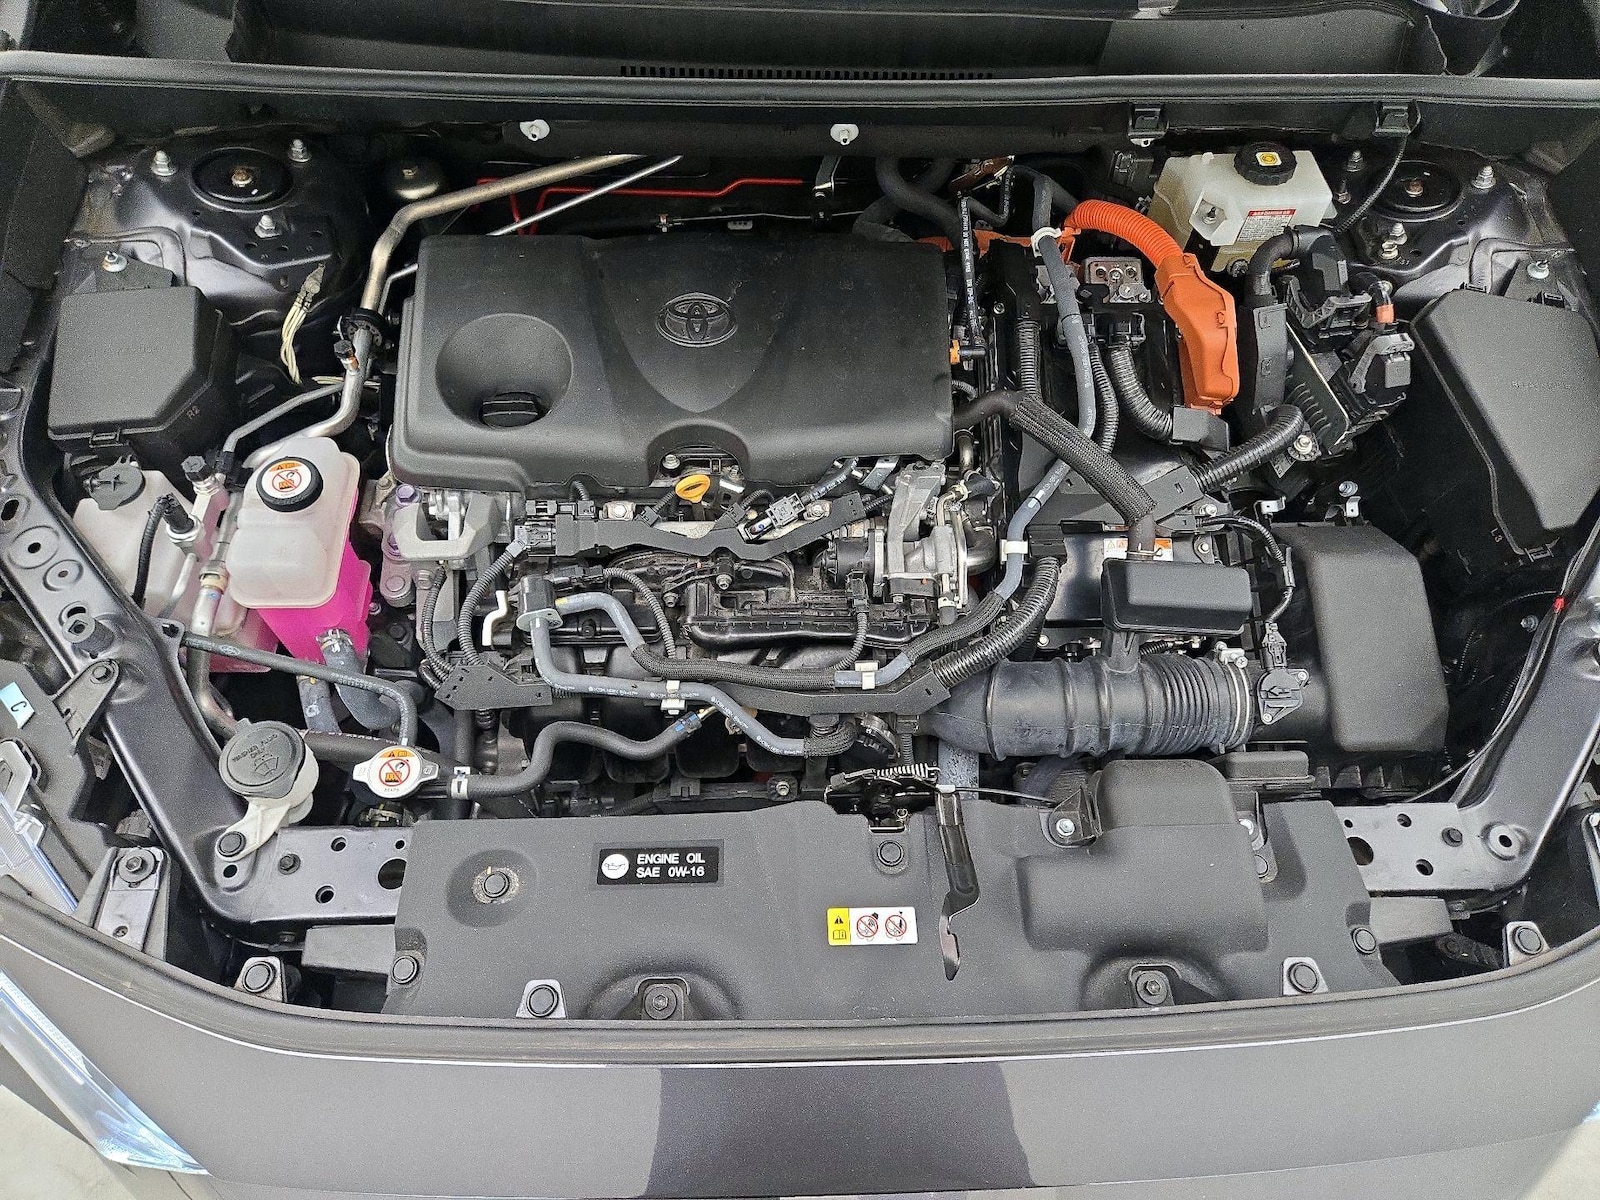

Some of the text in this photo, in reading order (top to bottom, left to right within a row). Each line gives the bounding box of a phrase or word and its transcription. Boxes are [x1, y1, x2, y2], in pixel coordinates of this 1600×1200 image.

[636, 852, 706, 865] ENGINE OIL
[635, 865, 705, 878] SAE 0W-16
